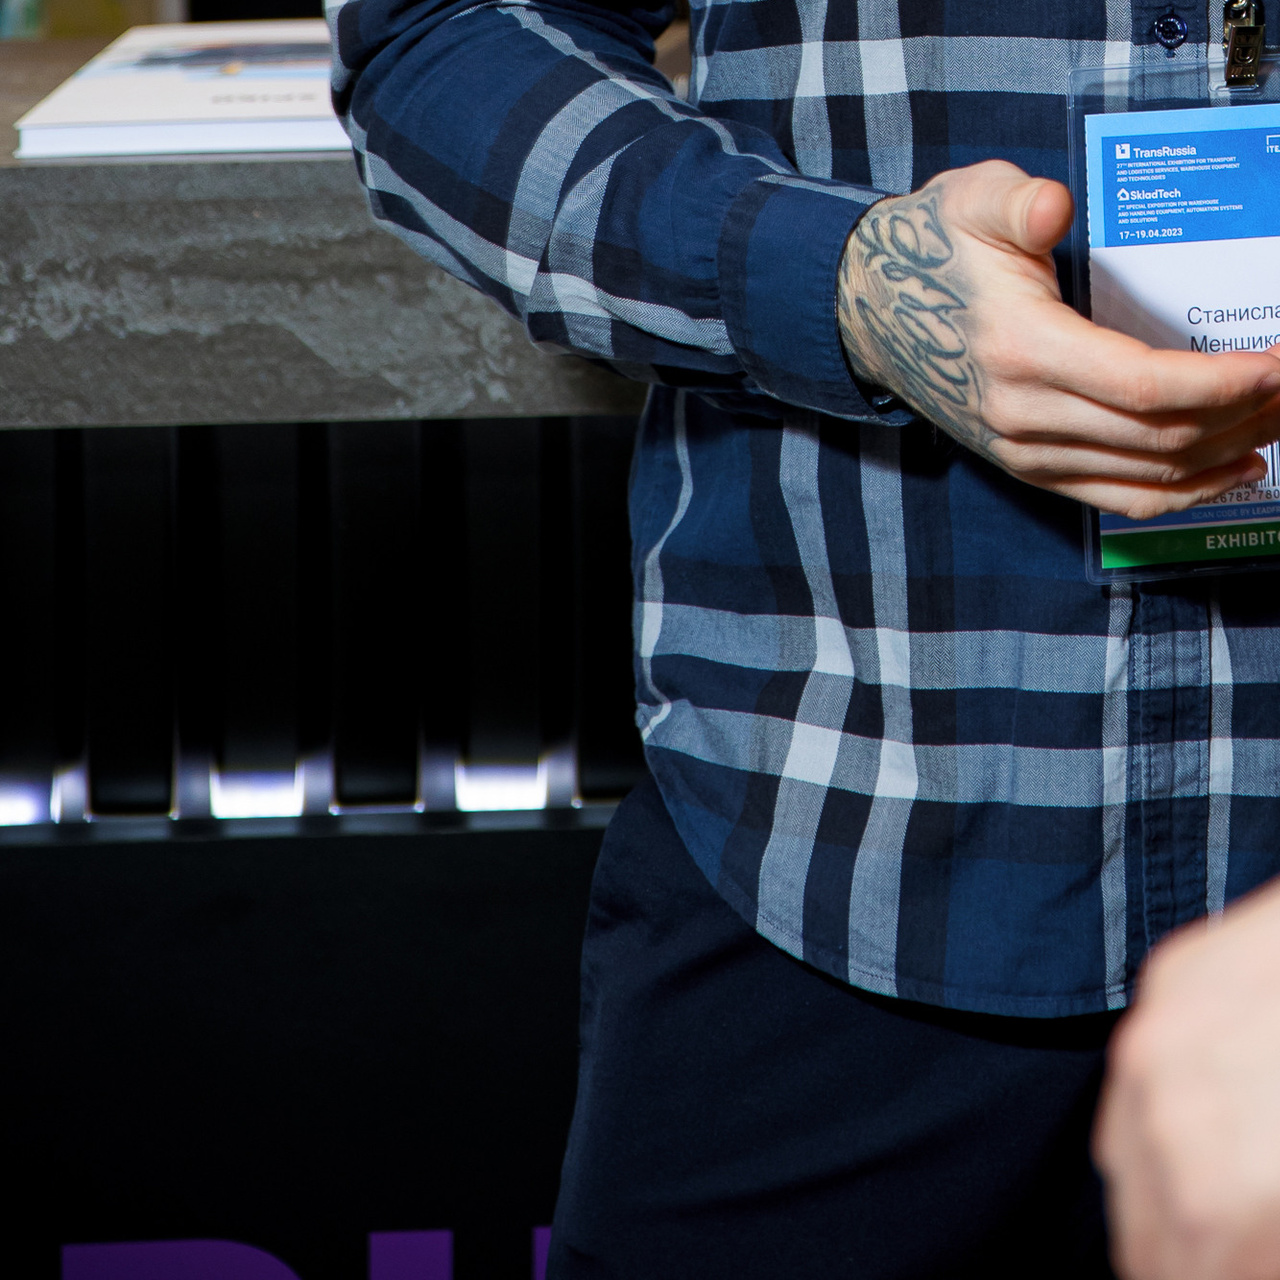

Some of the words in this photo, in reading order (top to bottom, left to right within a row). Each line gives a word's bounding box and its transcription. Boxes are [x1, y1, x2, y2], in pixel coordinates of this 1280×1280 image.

[1133, 145, 1197, 158] TransRussia
[1128, 160, 1167, 168] INTERNATIONAL
[1167, 158, 1196, 166] EXHIBITION
[1130, 188, 1181, 200] SkladTech
[1192, 511, 1215, 520] SCAN
[1216, 509, 1238, 518] CODE
[1239, 508, 1250, 517] BY
